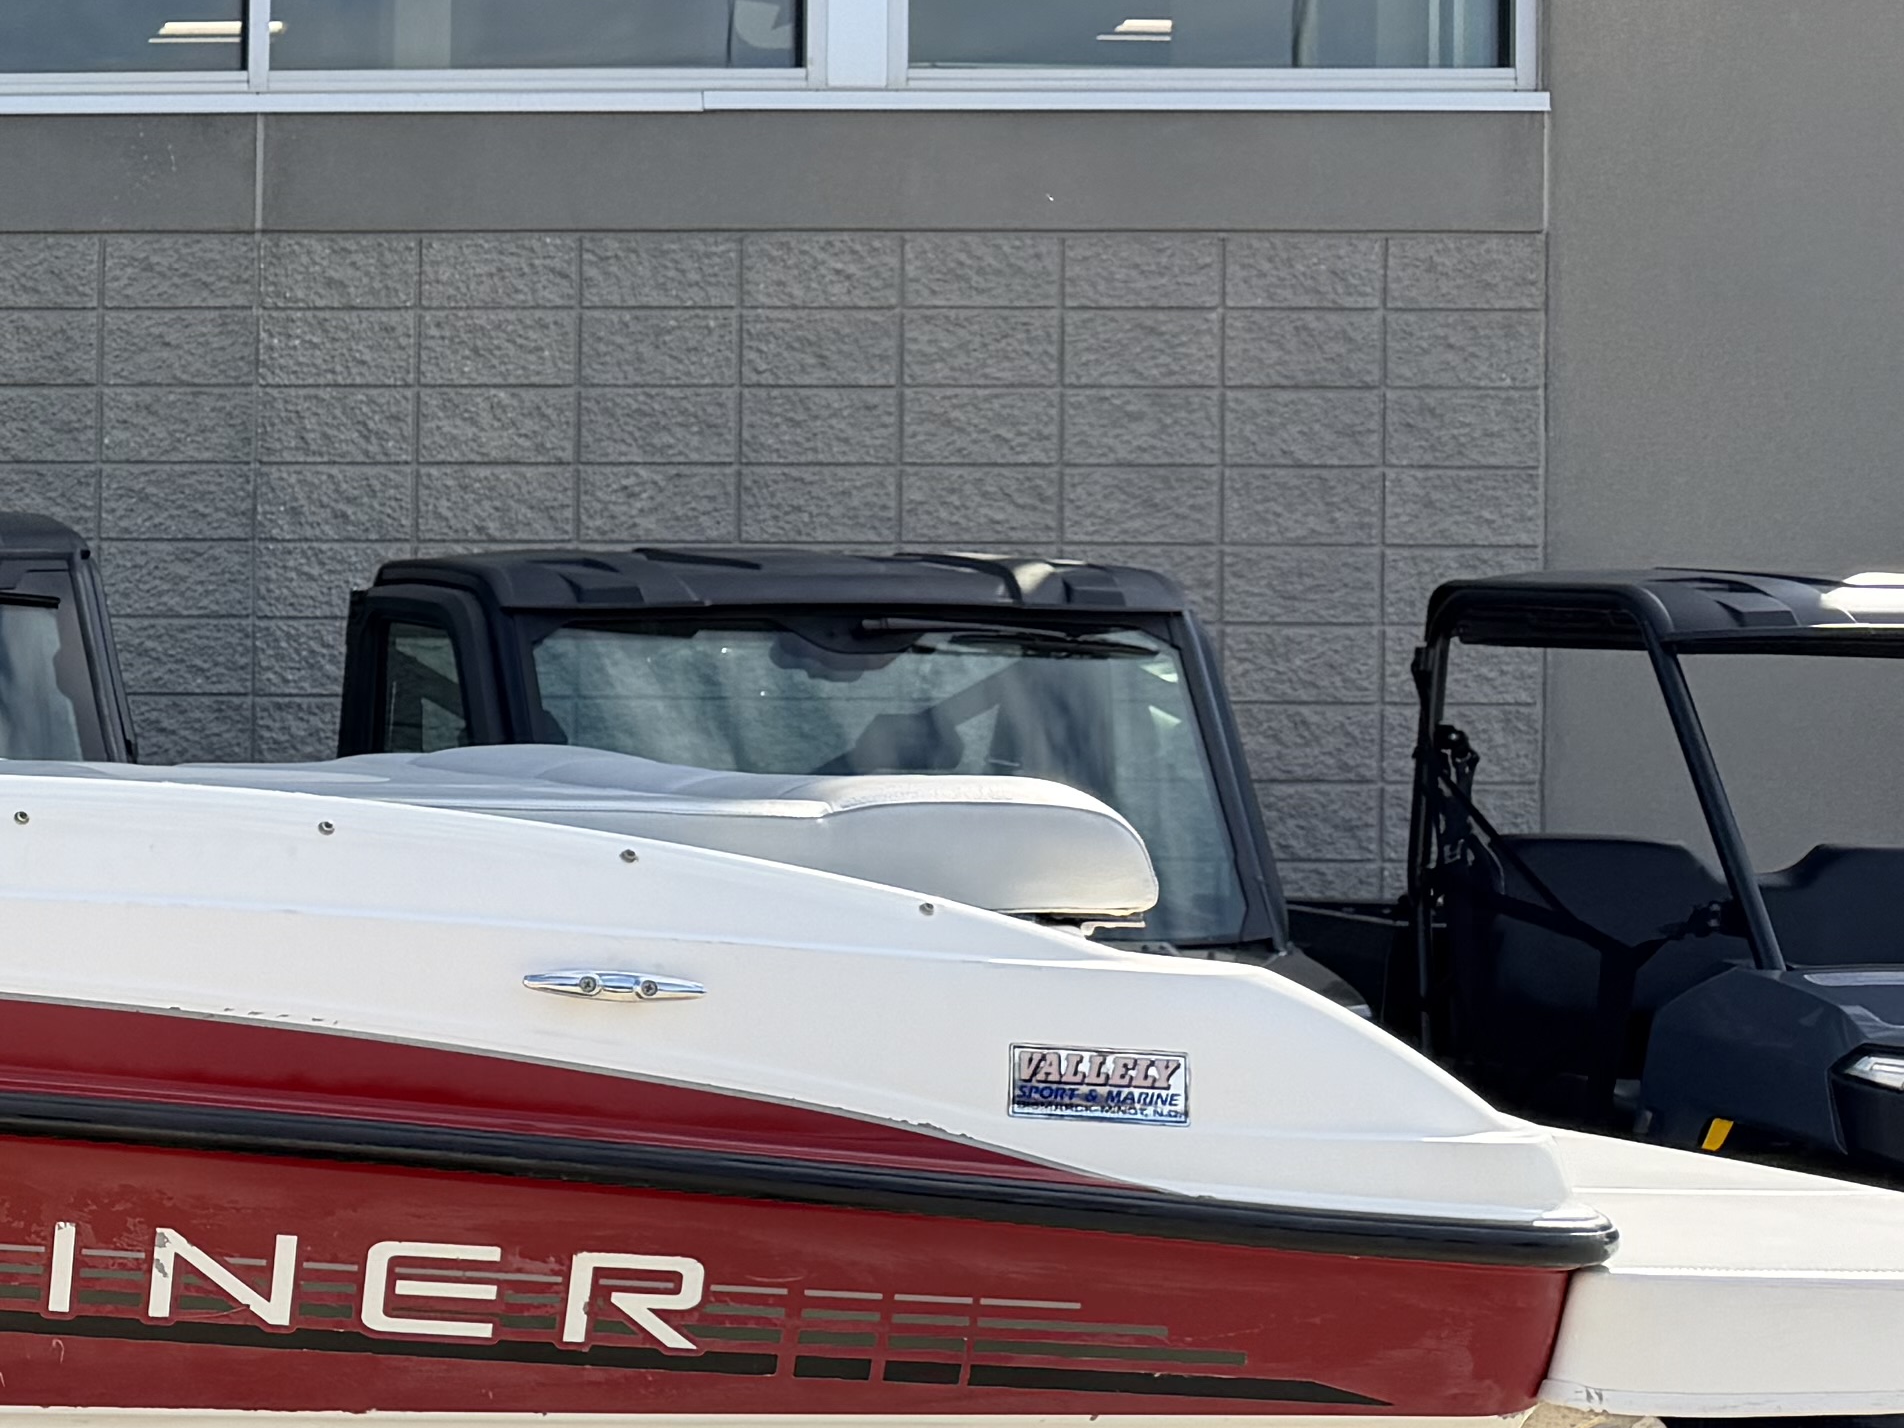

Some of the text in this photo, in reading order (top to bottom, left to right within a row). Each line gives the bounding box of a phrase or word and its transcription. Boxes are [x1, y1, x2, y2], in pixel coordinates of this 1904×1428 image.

[1018, 1051, 1182, 1090] VALLELY
[1016, 1085, 1182, 1107] SPORT & MARINE
